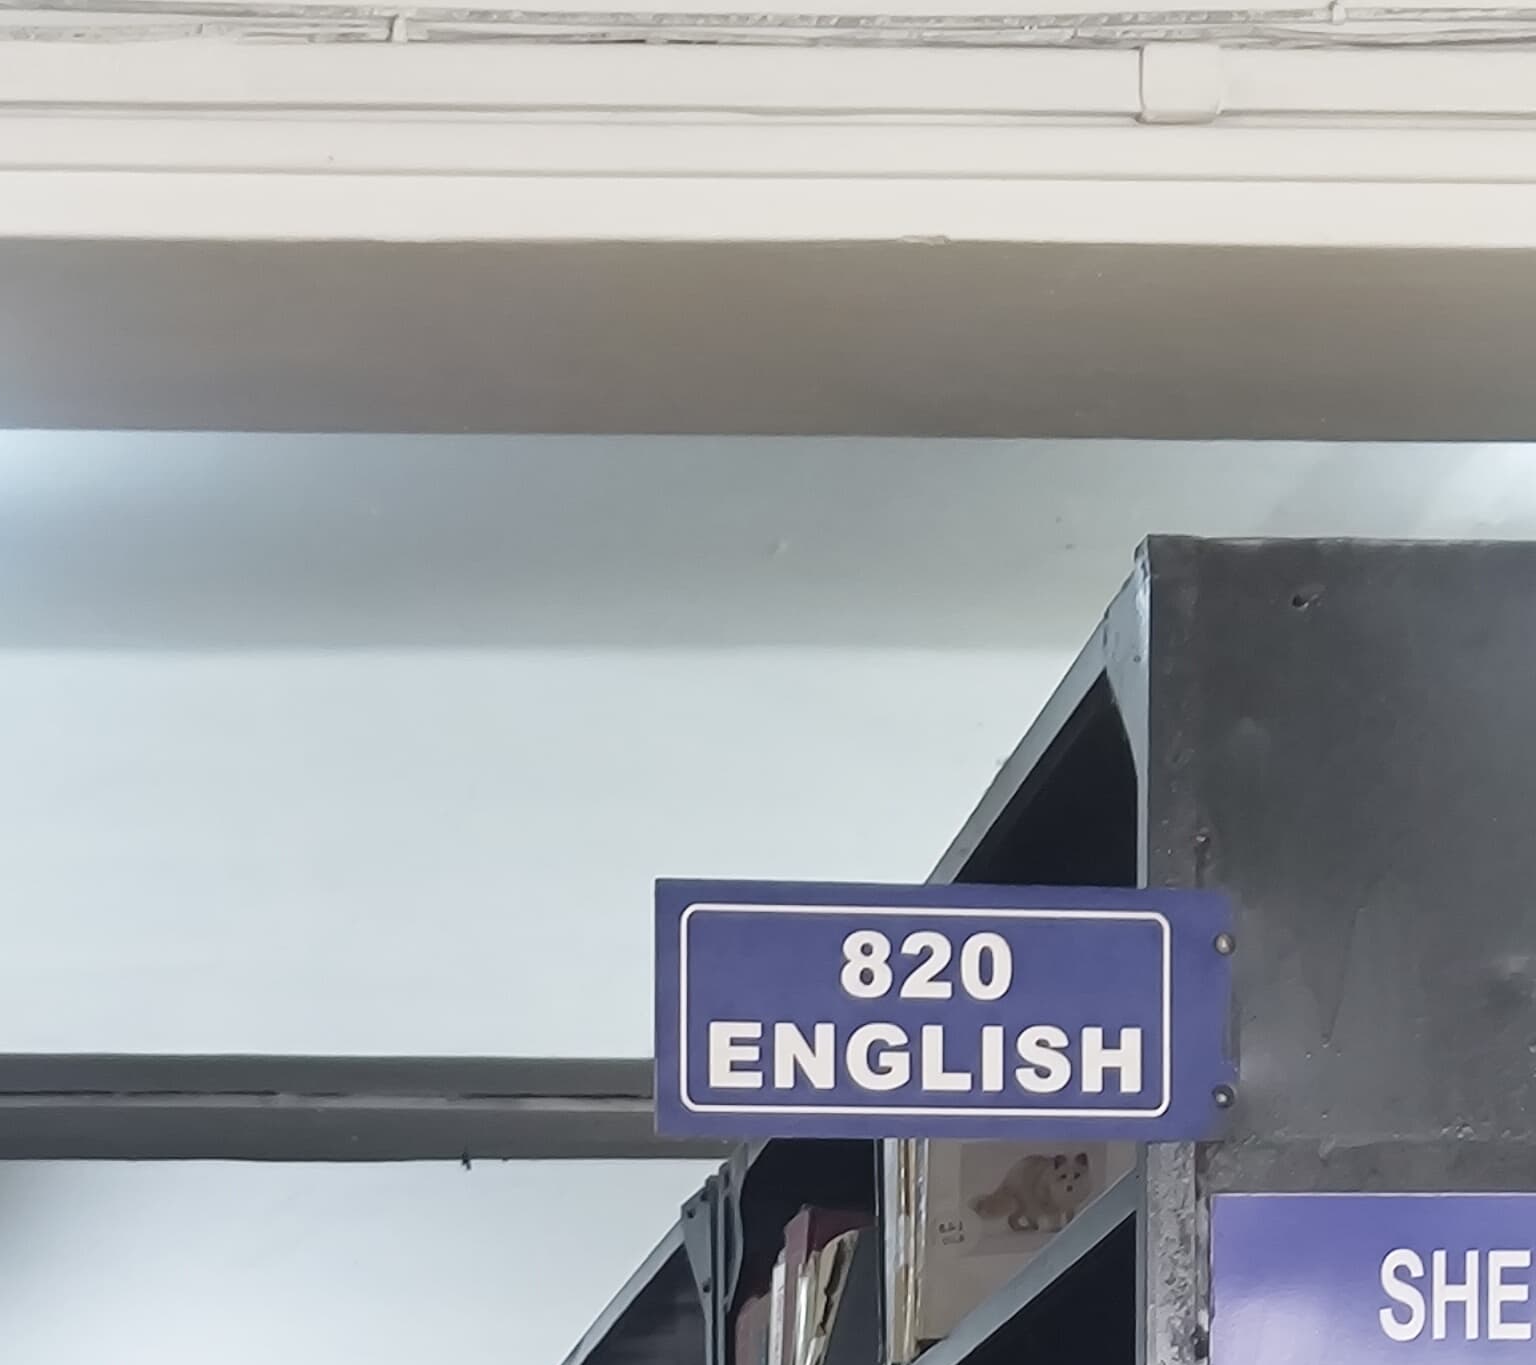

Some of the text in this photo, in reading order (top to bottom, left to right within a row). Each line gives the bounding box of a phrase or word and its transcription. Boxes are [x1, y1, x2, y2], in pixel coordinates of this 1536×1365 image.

[840, 930, 1013, 1001] 820
[709, 1021, 1142, 1094] ENGLISH
[1379, 1249, 1532, 1341] SHE
